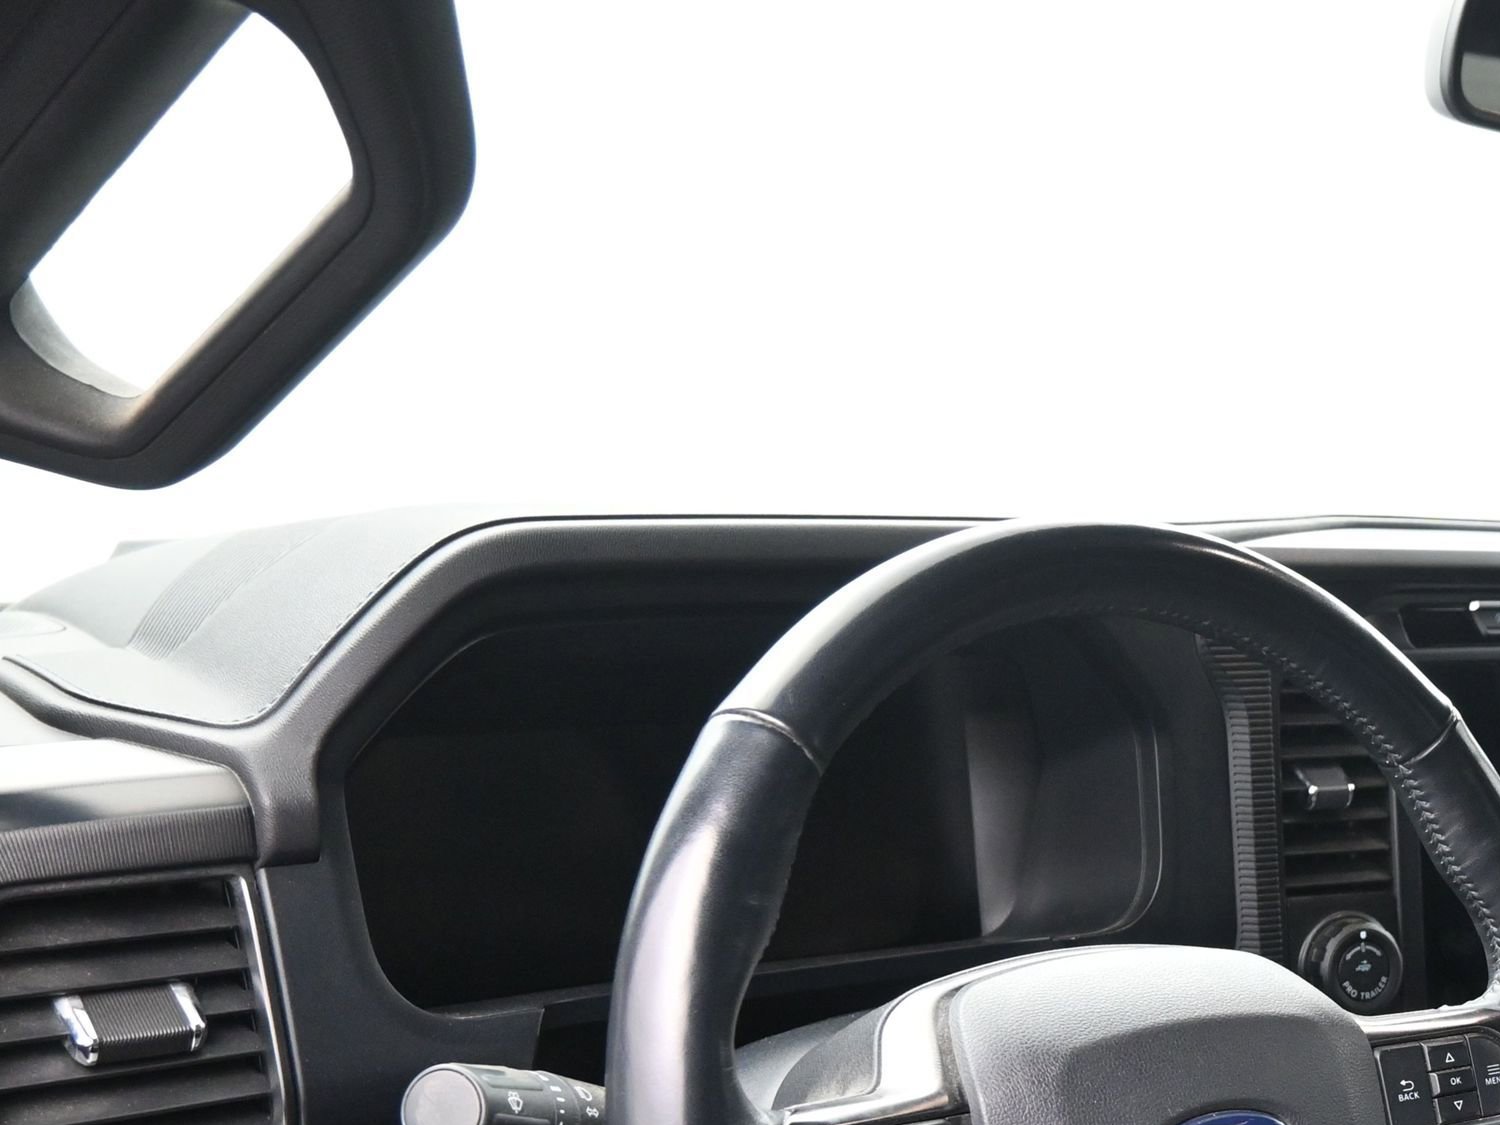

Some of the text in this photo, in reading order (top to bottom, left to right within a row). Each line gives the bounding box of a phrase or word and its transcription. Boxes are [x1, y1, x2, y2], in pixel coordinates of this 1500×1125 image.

[1341, 976, 1388, 1000] PRO TRAILER
[1450, 1077, 1463, 1085] OK
[1398, 1092, 1421, 1103] BACK
